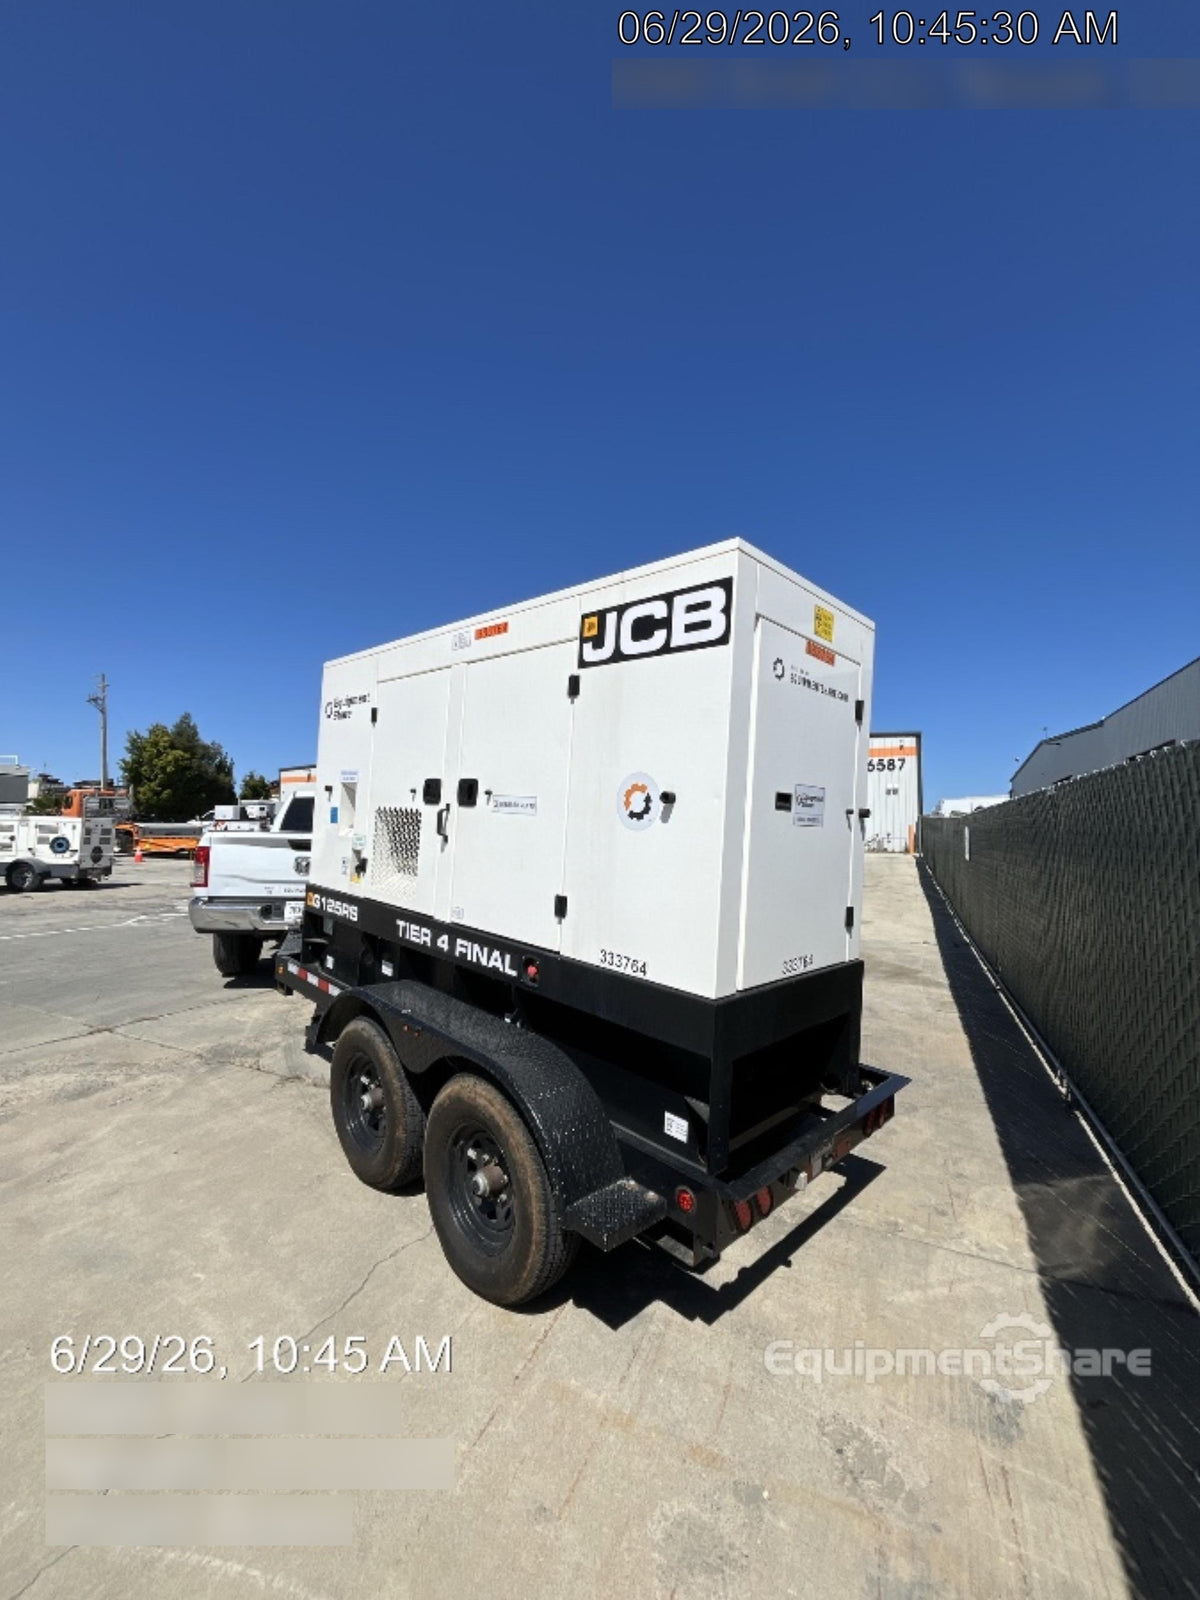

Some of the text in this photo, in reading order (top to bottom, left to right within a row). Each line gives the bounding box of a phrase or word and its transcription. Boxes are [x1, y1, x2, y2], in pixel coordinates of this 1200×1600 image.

[582, 586, 727, 662] JCB
[867, 758, 906, 772] 6587
[396, 918, 519, 977] TIER 4 FINAL
[600, 948, 647, 977] 333764
